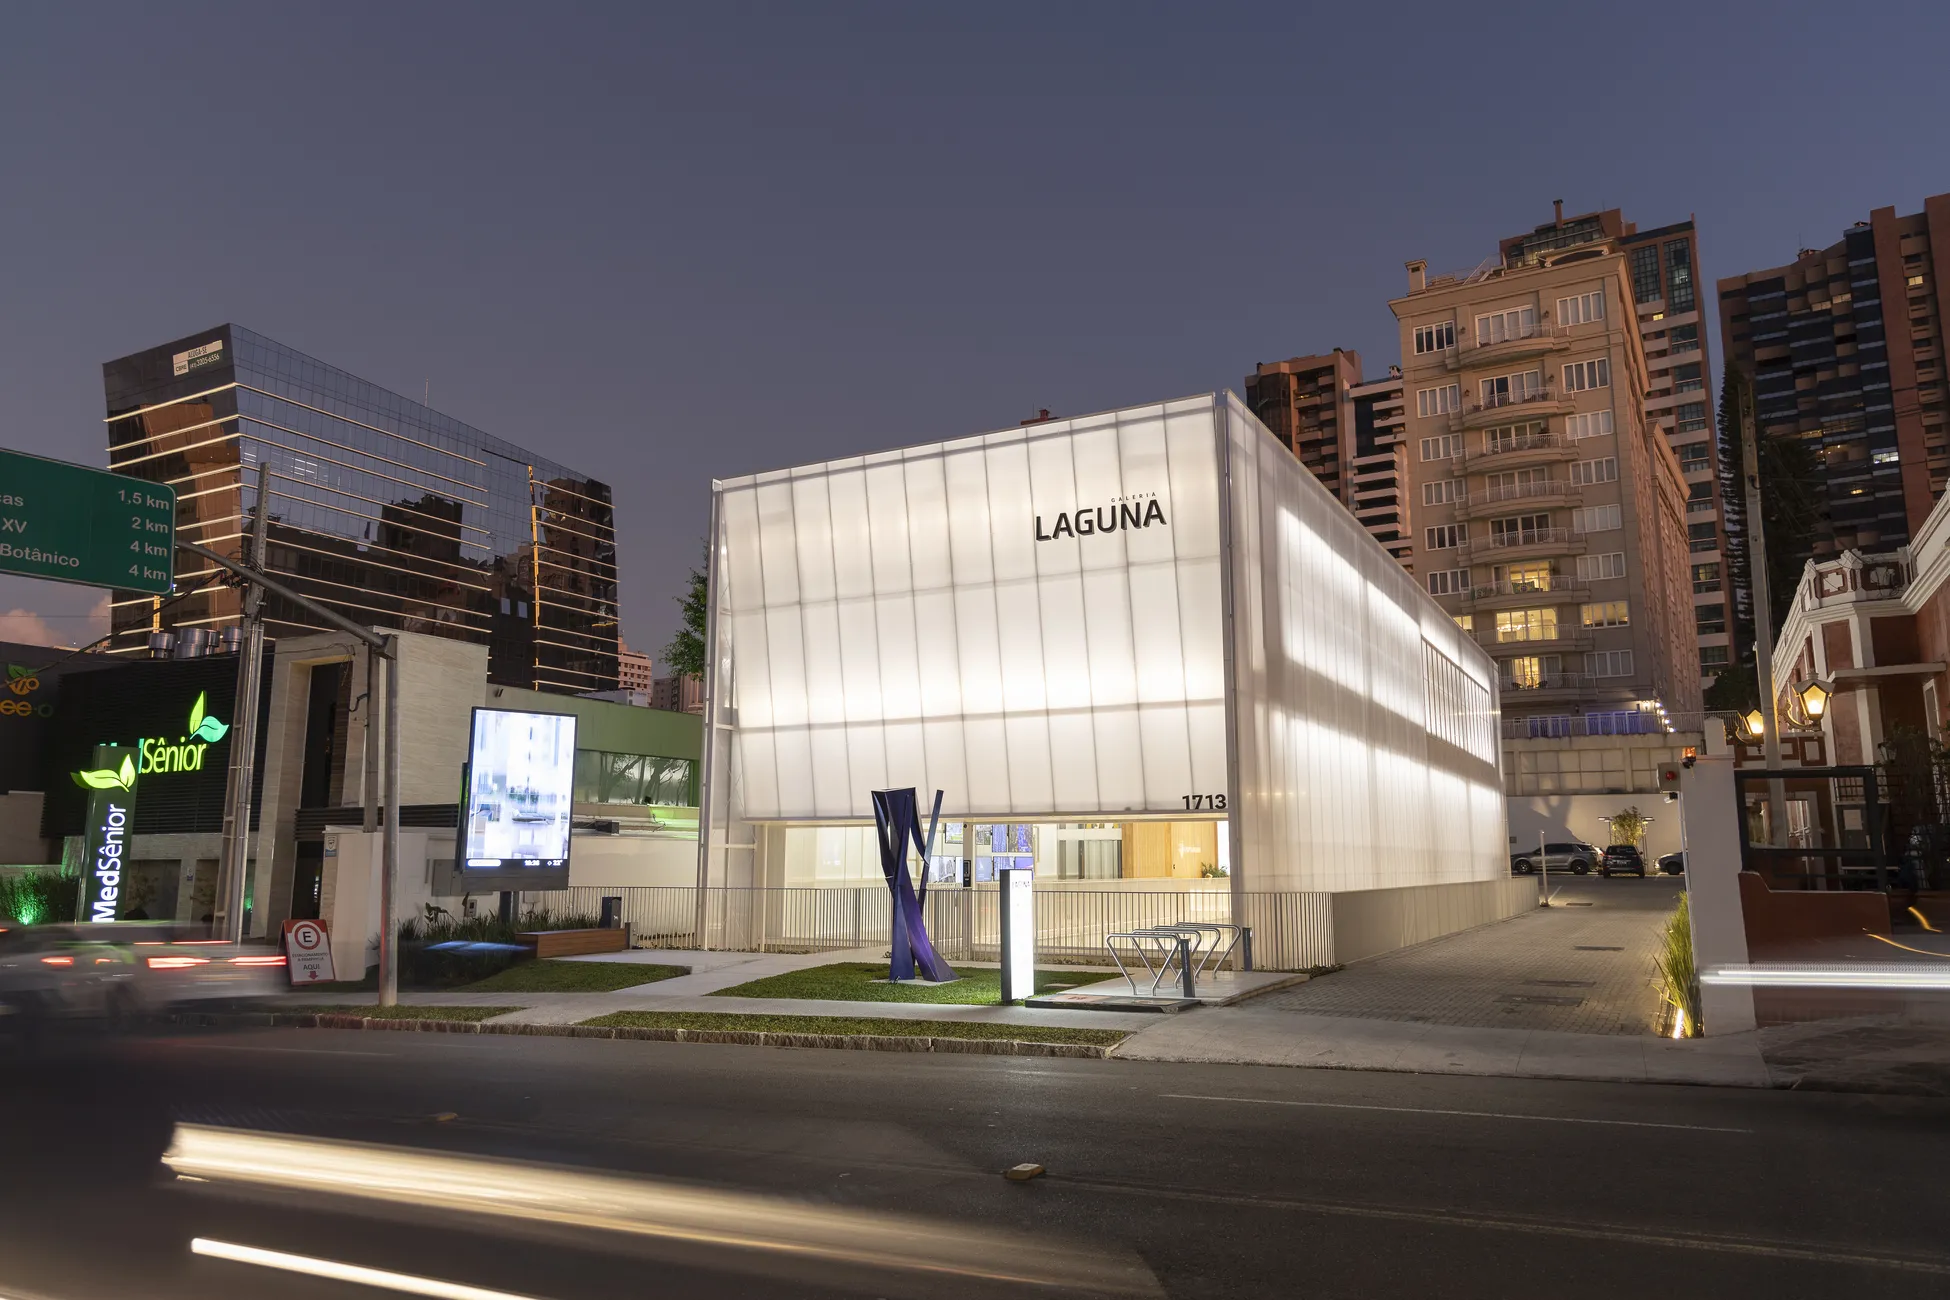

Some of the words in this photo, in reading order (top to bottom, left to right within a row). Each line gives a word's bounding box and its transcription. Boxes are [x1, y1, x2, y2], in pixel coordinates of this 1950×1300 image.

[0, 493, 24, 507] as
[118, 489, 142, 505] 1,5
[146, 494, 170, 511] km
[1110, 491, 1157, 503] GALERIA
[2, 517, 28, 534] XV
[131, 517, 142, 530] 2
[145, 521, 169, 534] km
[1035, 499, 1168, 542] LAGUNA
[130, 540, 140, 552] 4
[144, 544, 168, 558] km
[0, 542, 81, 568] Botânico
[128, 564, 139, 577] 4
[143, 568, 167, 581] km
[98, 737, 208, 774] Sênior
[1181, 793, 1227, 810] 1713
[92, 803, 127, 923] MedSênior
[302, 931, 313, 943] E
[303, 963, 321, 971] AQUI
